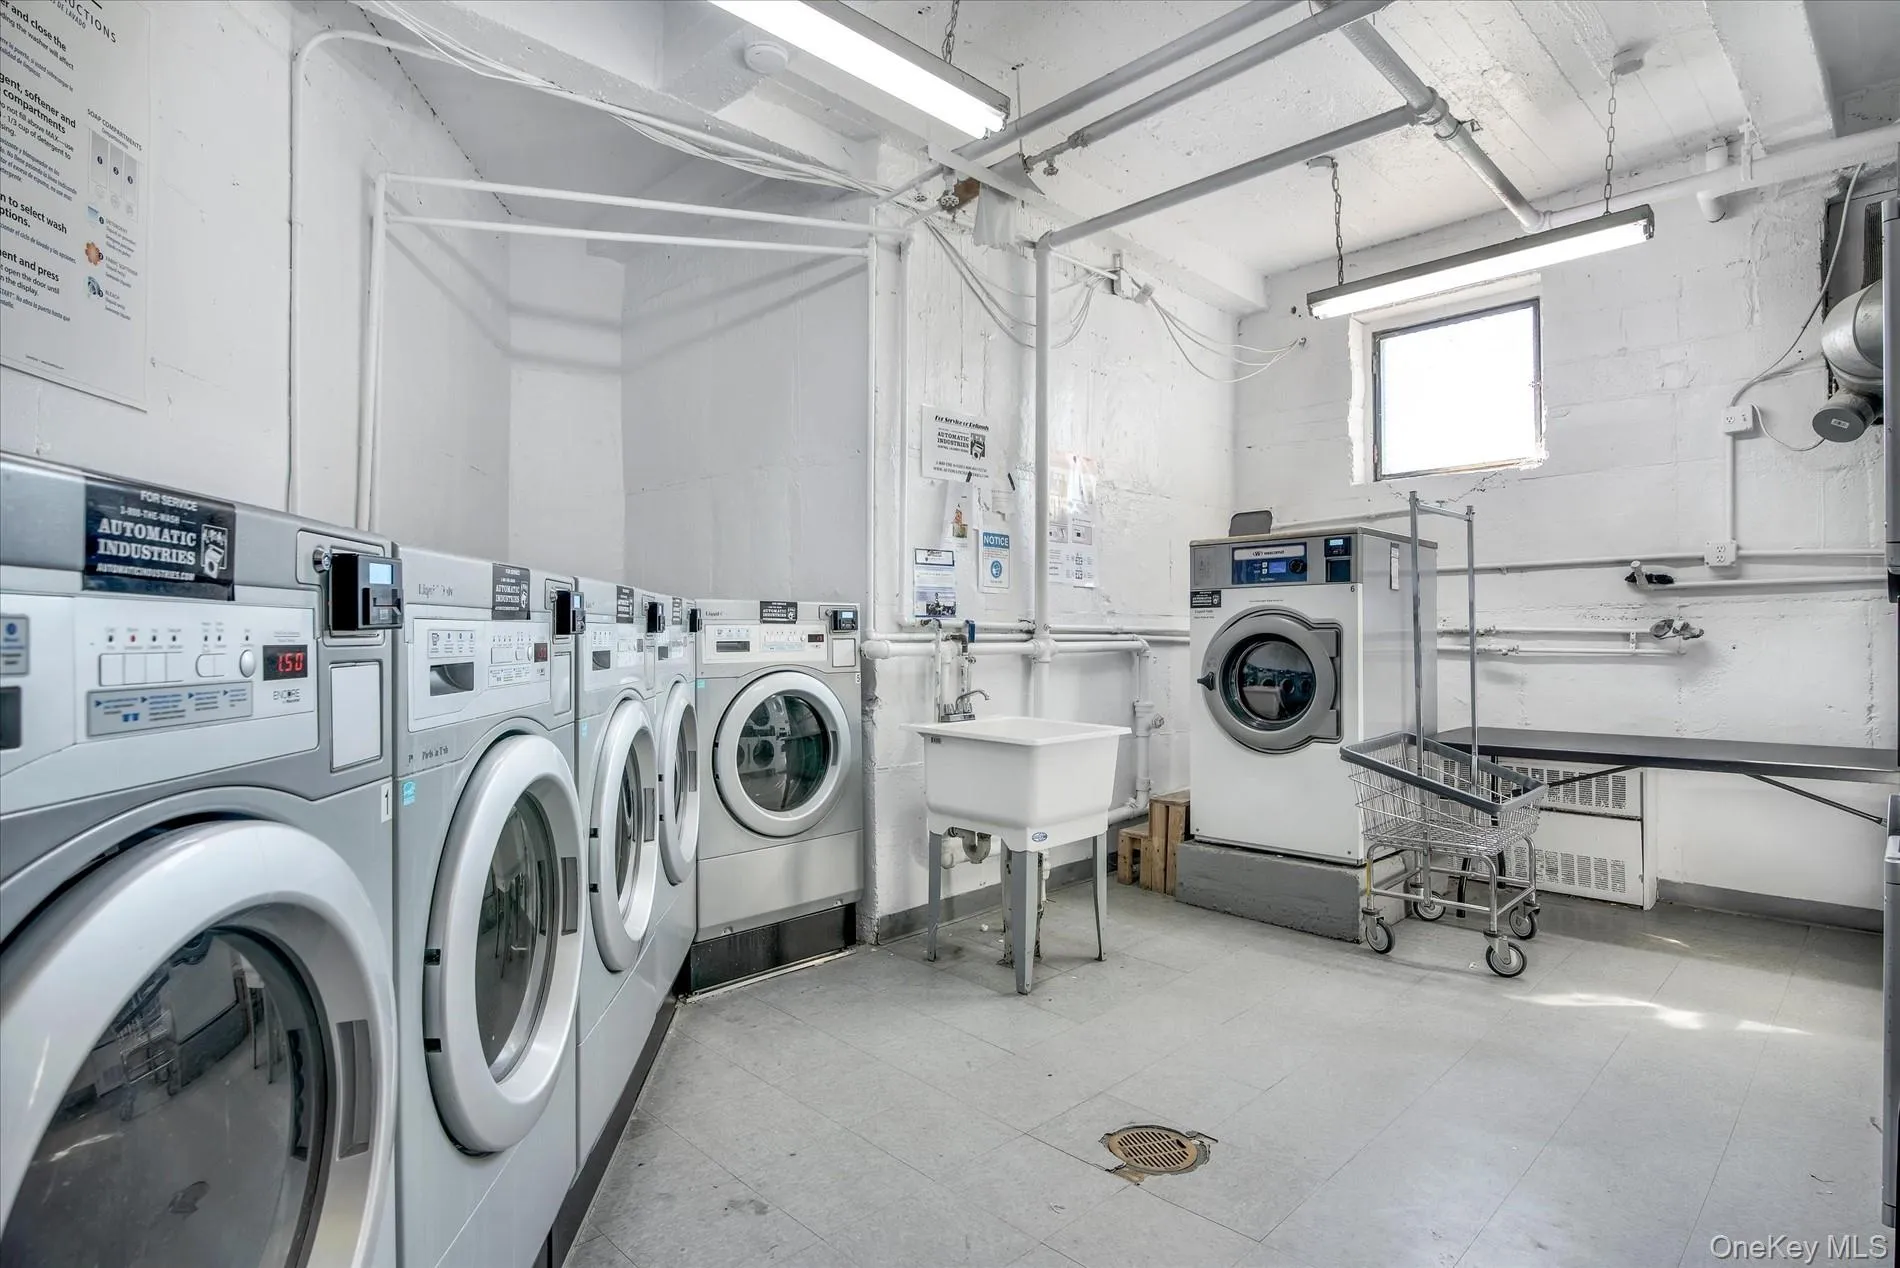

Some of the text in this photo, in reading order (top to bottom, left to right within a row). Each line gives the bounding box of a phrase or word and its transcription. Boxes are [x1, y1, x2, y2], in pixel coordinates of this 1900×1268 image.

[11, 5, 29, 23] and
[30, 20, 53, 41] close
[53, 35, 67, 52] the
[16, 22, 27, 35] the
[27, 31, 49, 50] washer
[49, 47, 59, 59] will
[59, 54, 74, 70] affect
[3, 89, 66, 135] compartments
[6, 105, 18, 117] not
[18, 111, 27, 121] fill
[27, 117, 45, 134] above
[24, 89, 60, 118] softener
[60, 113, 76, 129] and
[18, 123, 30, 135] cup
[30, 130, 37, 138] of
[37, 134, 64, 157] detergent
[64, 151, 72, 160] to
[101, 118, 142, 151] COMPARTMENTS
[8, 195, 19, 208] to
[20, 203, 46, 223] select
[46, 216, 68, 235] wash
[4, 265, 21, 278] open
[21, 271, 32, 283] the
[32, 277, 47, 290] door
[46, 284, 60, 296] until
[18, 257, 36, 272] and
[37, 265, 60, 283] press
[5, 275, 17, 288] the
[16, 281, 40, 297] display.
[944, 416, 962, 425] Service
[937, 431, 970, 442] AUTOMATIC
[937, 438, 970, 448] INDUSTRIES
[139, 489, 199, 513] FOR SERVICE
[97, 517, 197, 547] AUTOMATIC
[983, 535, 1009, 547] NOTICE
[96, 538, 196, 566] INDUSTRIES
[96, 562, 196, 581] AUTOMATICINDUSTRIES.COM
[1350, 585, 1356, 593] 6
